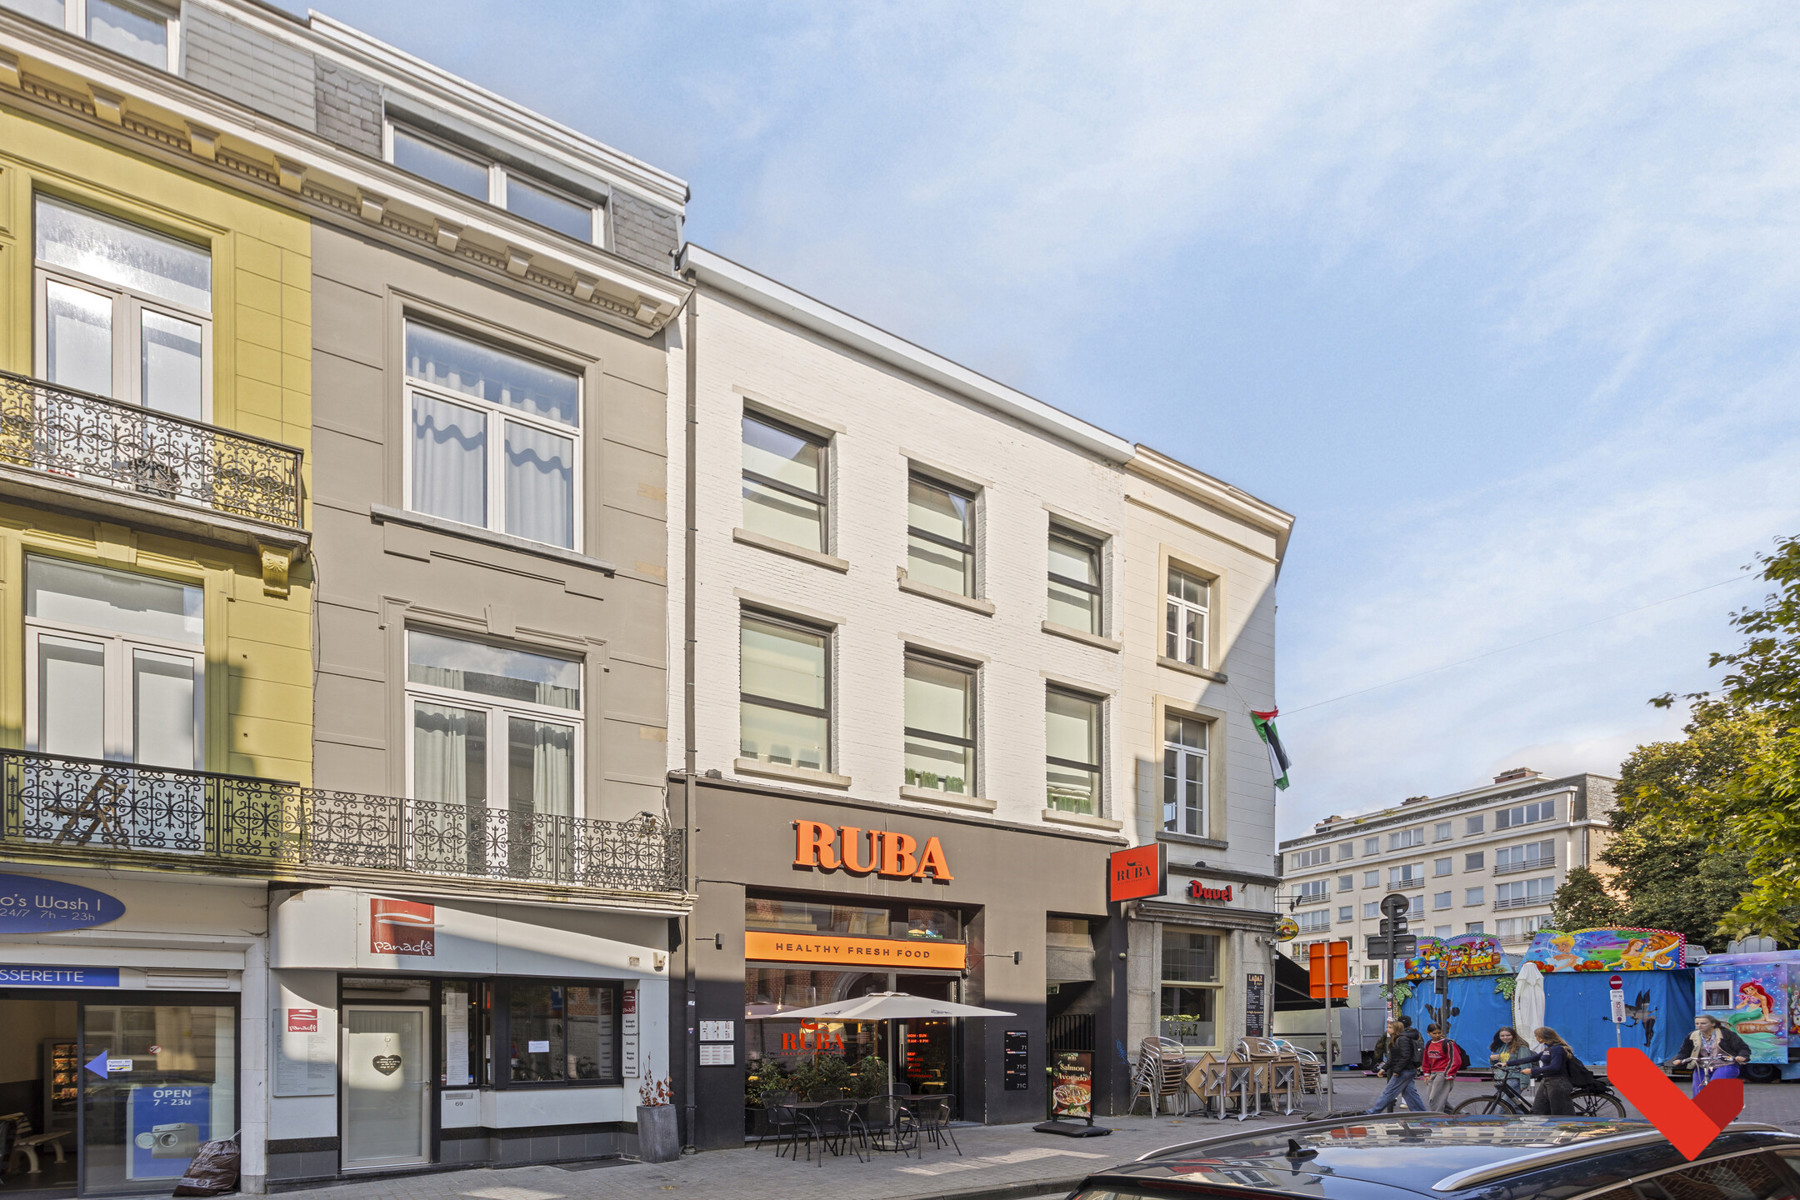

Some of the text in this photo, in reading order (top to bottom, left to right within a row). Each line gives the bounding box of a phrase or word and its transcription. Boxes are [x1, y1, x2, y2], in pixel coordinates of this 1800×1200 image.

[793, 819, 955, 881] RUBA
[1116, 865, 1151, 881] RUBA
[1189, 880, 1233, 902] Duvel
[35, 895, 89, 911] Wash
[40, 910, 56, 919] 7h
[71, 911, 96, 921] 23h
[775, 942, 931, 958] HEALTHY FRESH FOOD
[781, 1032, 846, 1050] RUBA
[1059, 1063, 1085, 1072] Salmon
[152, 1089, 192, 1098] OPEN
